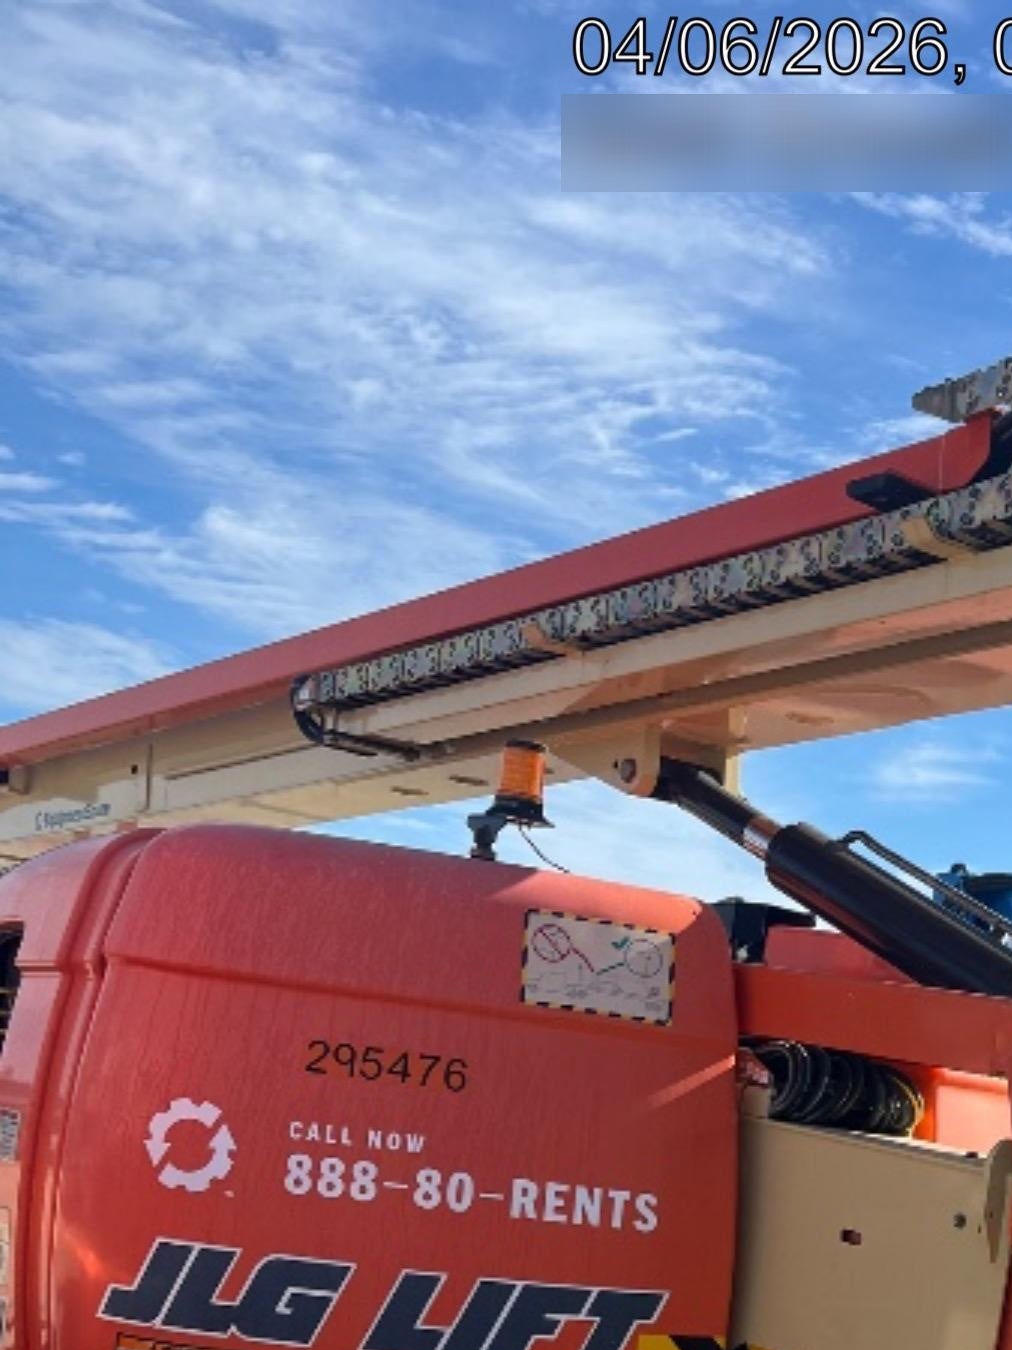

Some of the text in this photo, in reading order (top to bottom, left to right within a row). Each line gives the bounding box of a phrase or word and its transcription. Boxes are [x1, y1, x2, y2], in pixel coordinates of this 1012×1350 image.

[305, 1040, 468, 1093] 295476
[289, 1121, 425, 1153] CALL NOW
[283, 1154, 659, 1233] 888-80-RENTS
[97, 1237, 357, 1347] JLG
